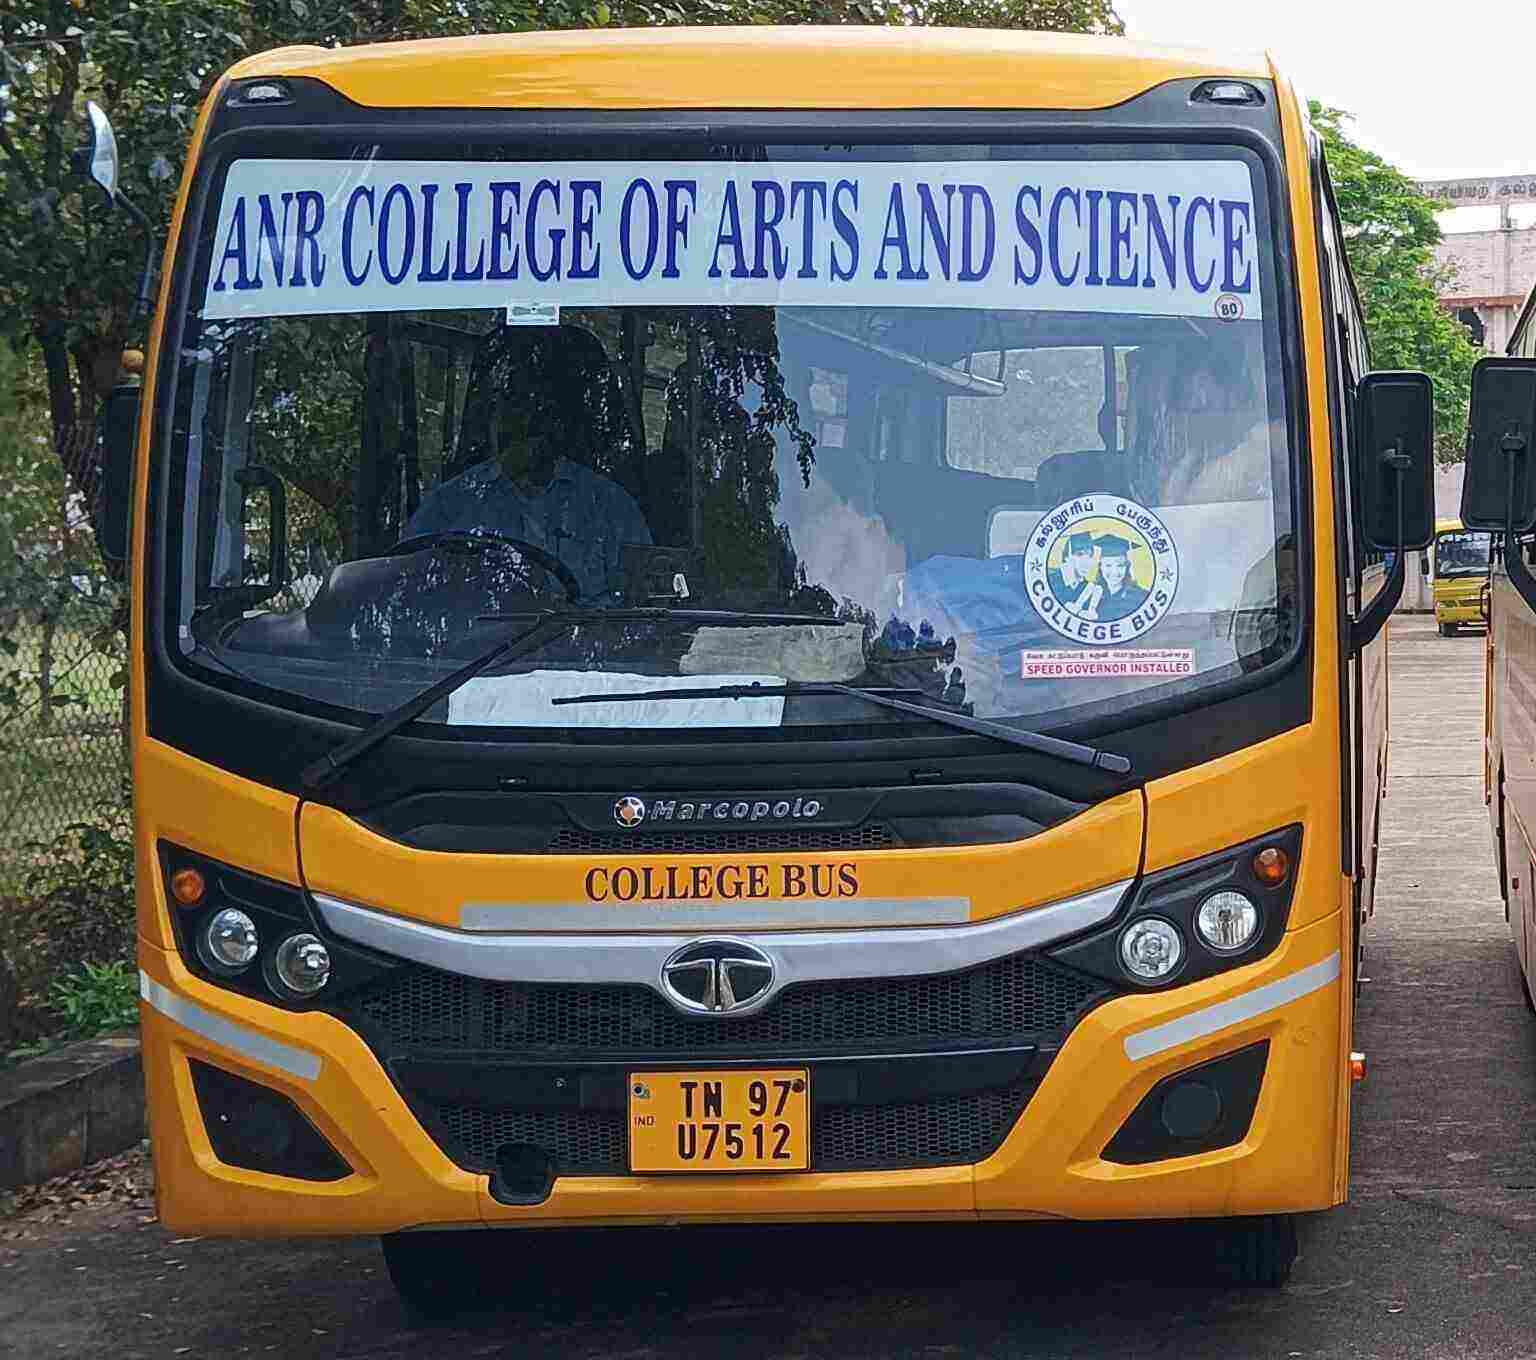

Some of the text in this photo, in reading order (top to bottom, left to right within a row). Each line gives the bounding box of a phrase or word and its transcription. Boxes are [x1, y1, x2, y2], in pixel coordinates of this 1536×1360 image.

[212, 178, 1252, 294] ANR COLLEGE OF ARTS AND SCIENCE
[1221, 303, 1238, 315] 80
[1032, 580, 1168, 640] COLLEGE BUS
[1026, 662, 1190, 674] SPEED GOVERNOR INSTALLED
[651, 798, 820, 821] Marcopolo
[585, 863, 859, 901] COLLEGE BUS
[680, 1081, 792, 1118] TN 97
[633, 1116, 655, 1126] IND
[677, 1123, 791, 1160] U7512
